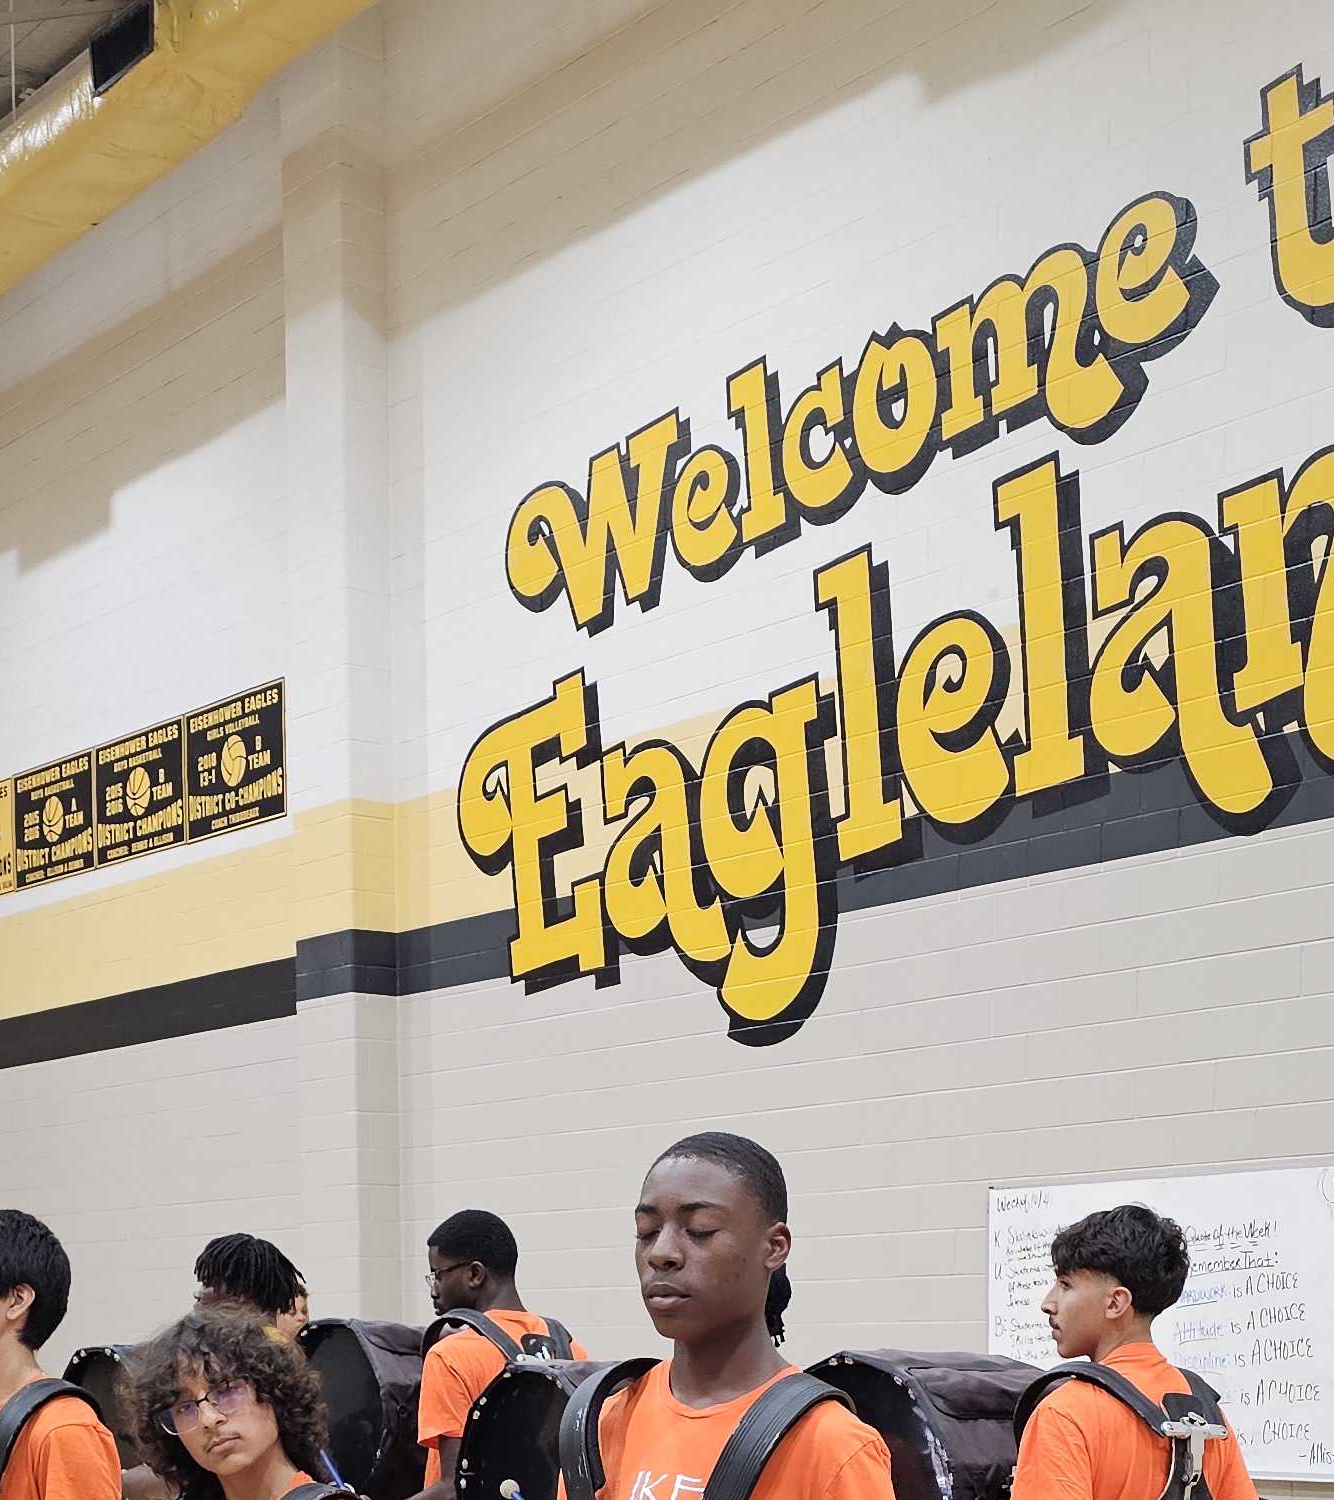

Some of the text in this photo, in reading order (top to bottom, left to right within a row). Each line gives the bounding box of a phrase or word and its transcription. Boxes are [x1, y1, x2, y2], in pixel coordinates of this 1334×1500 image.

[507, 191, 1218, 636] Welcome
[189, 688, 279, 734] EISENHOWER EAGLES
[206, 714, 260, 742] GIRLS VOLLEYBALL
[98, 724, 179, 764] EISENHOWER EAGLES
[255, 735, 262, 751] B
[247, 749, 271, 771] TEAM
[16, 756, 89, 793] EISENHOWER EAGLES
[199, 768, 216, 787] 13-1
[71, 797, 78, 812] A
[151, 781, 173, 801] TEAM
[188, 766, 283, 822] DISTRICT CO-CHAMPIONS
[65, 810, 84, 829] TEAM
[97, 798, 183, 849] DISTRICT CHAMPIONS
[16, 847, 49, 872] DISTRICT
[51, 826, 92, 861] CHAMPIONS
[1245, 1276, 1254, 1296] A
[1256, 1272, 1299, 1294] CHOICE
[1246, 1310, 1256, 1331] A
[1259, 1303, 1306, 1329] CHOICE
[1251, 1338, 1261, 1366] A
[1263, 1338, 1314, 1362] CHOICE
[1256, 1379, 1265, 1407] A
[1262, 1418, 1311, 1445] CHOICE
